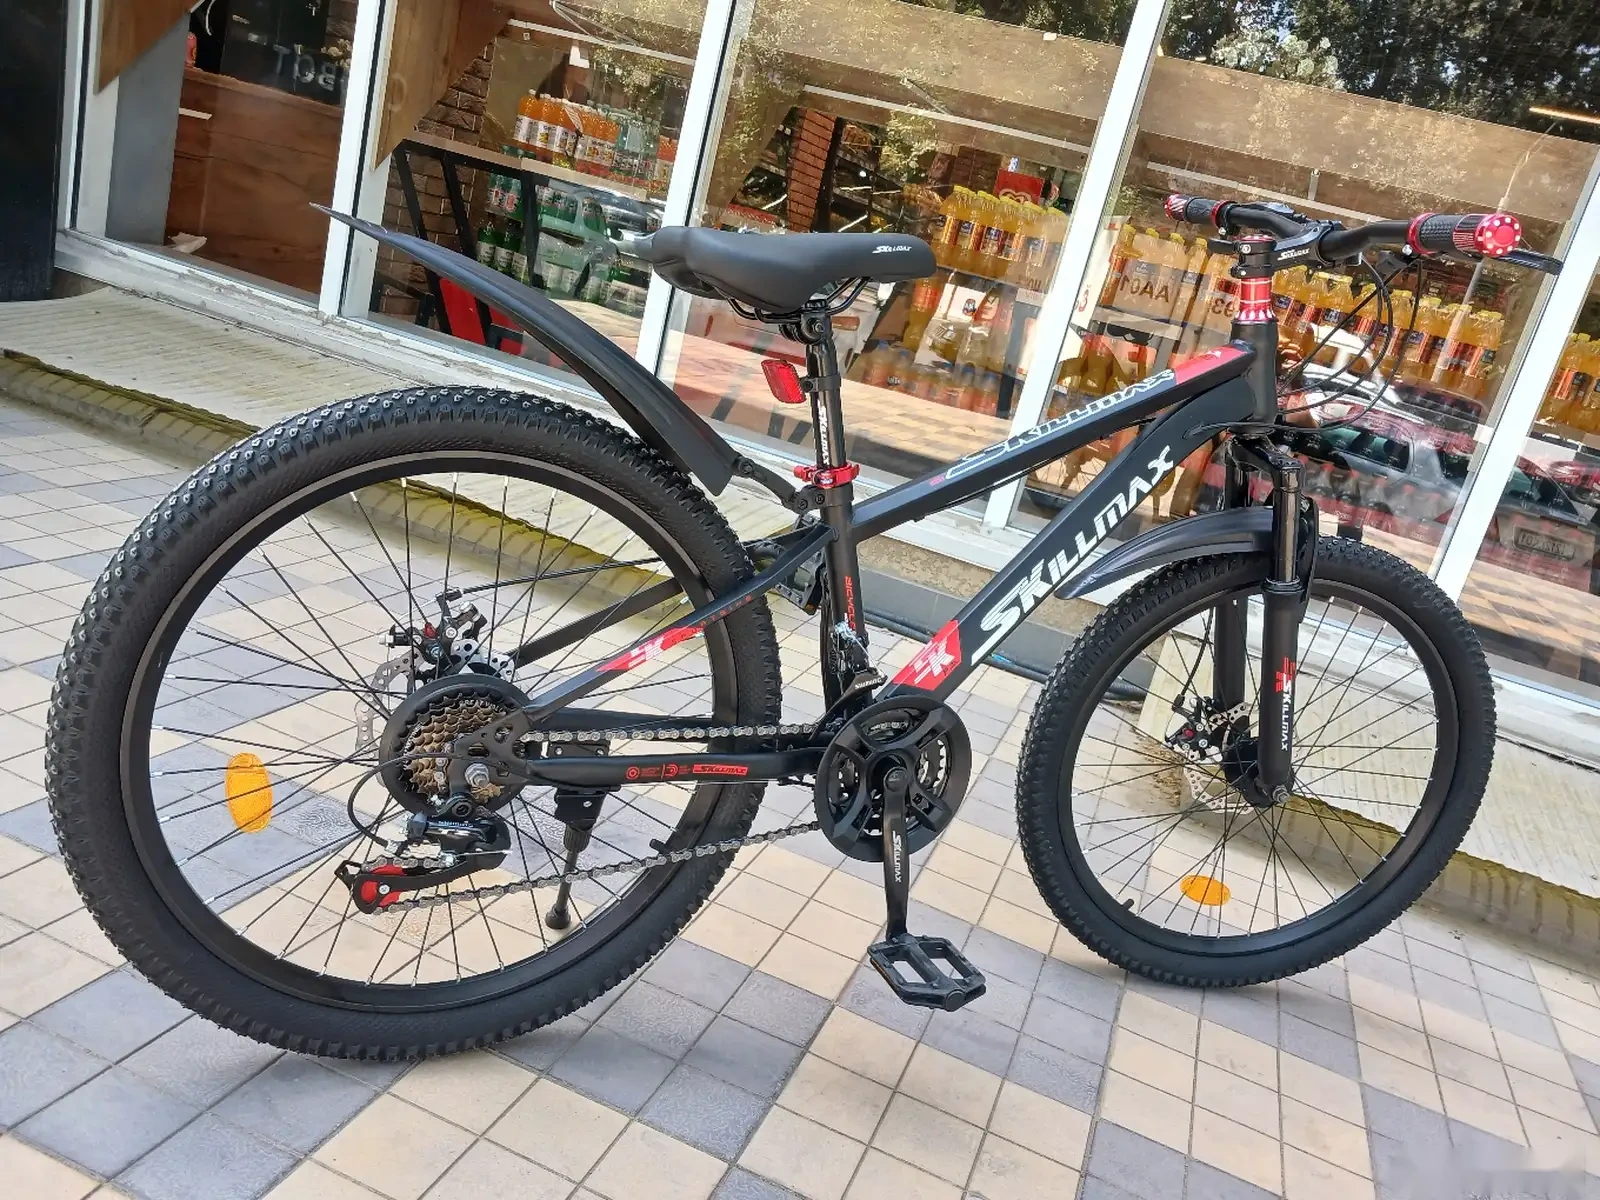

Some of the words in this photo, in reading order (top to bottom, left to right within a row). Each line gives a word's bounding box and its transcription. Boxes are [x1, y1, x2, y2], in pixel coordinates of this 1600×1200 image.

[971, 445, 1174, 667] SKILLMAX
[844, 575, 857, 630] BICYCLE
[1281, 672, 1292, 752] SKILLMAX
[892, 831, 902, 883] SKILLMAX
